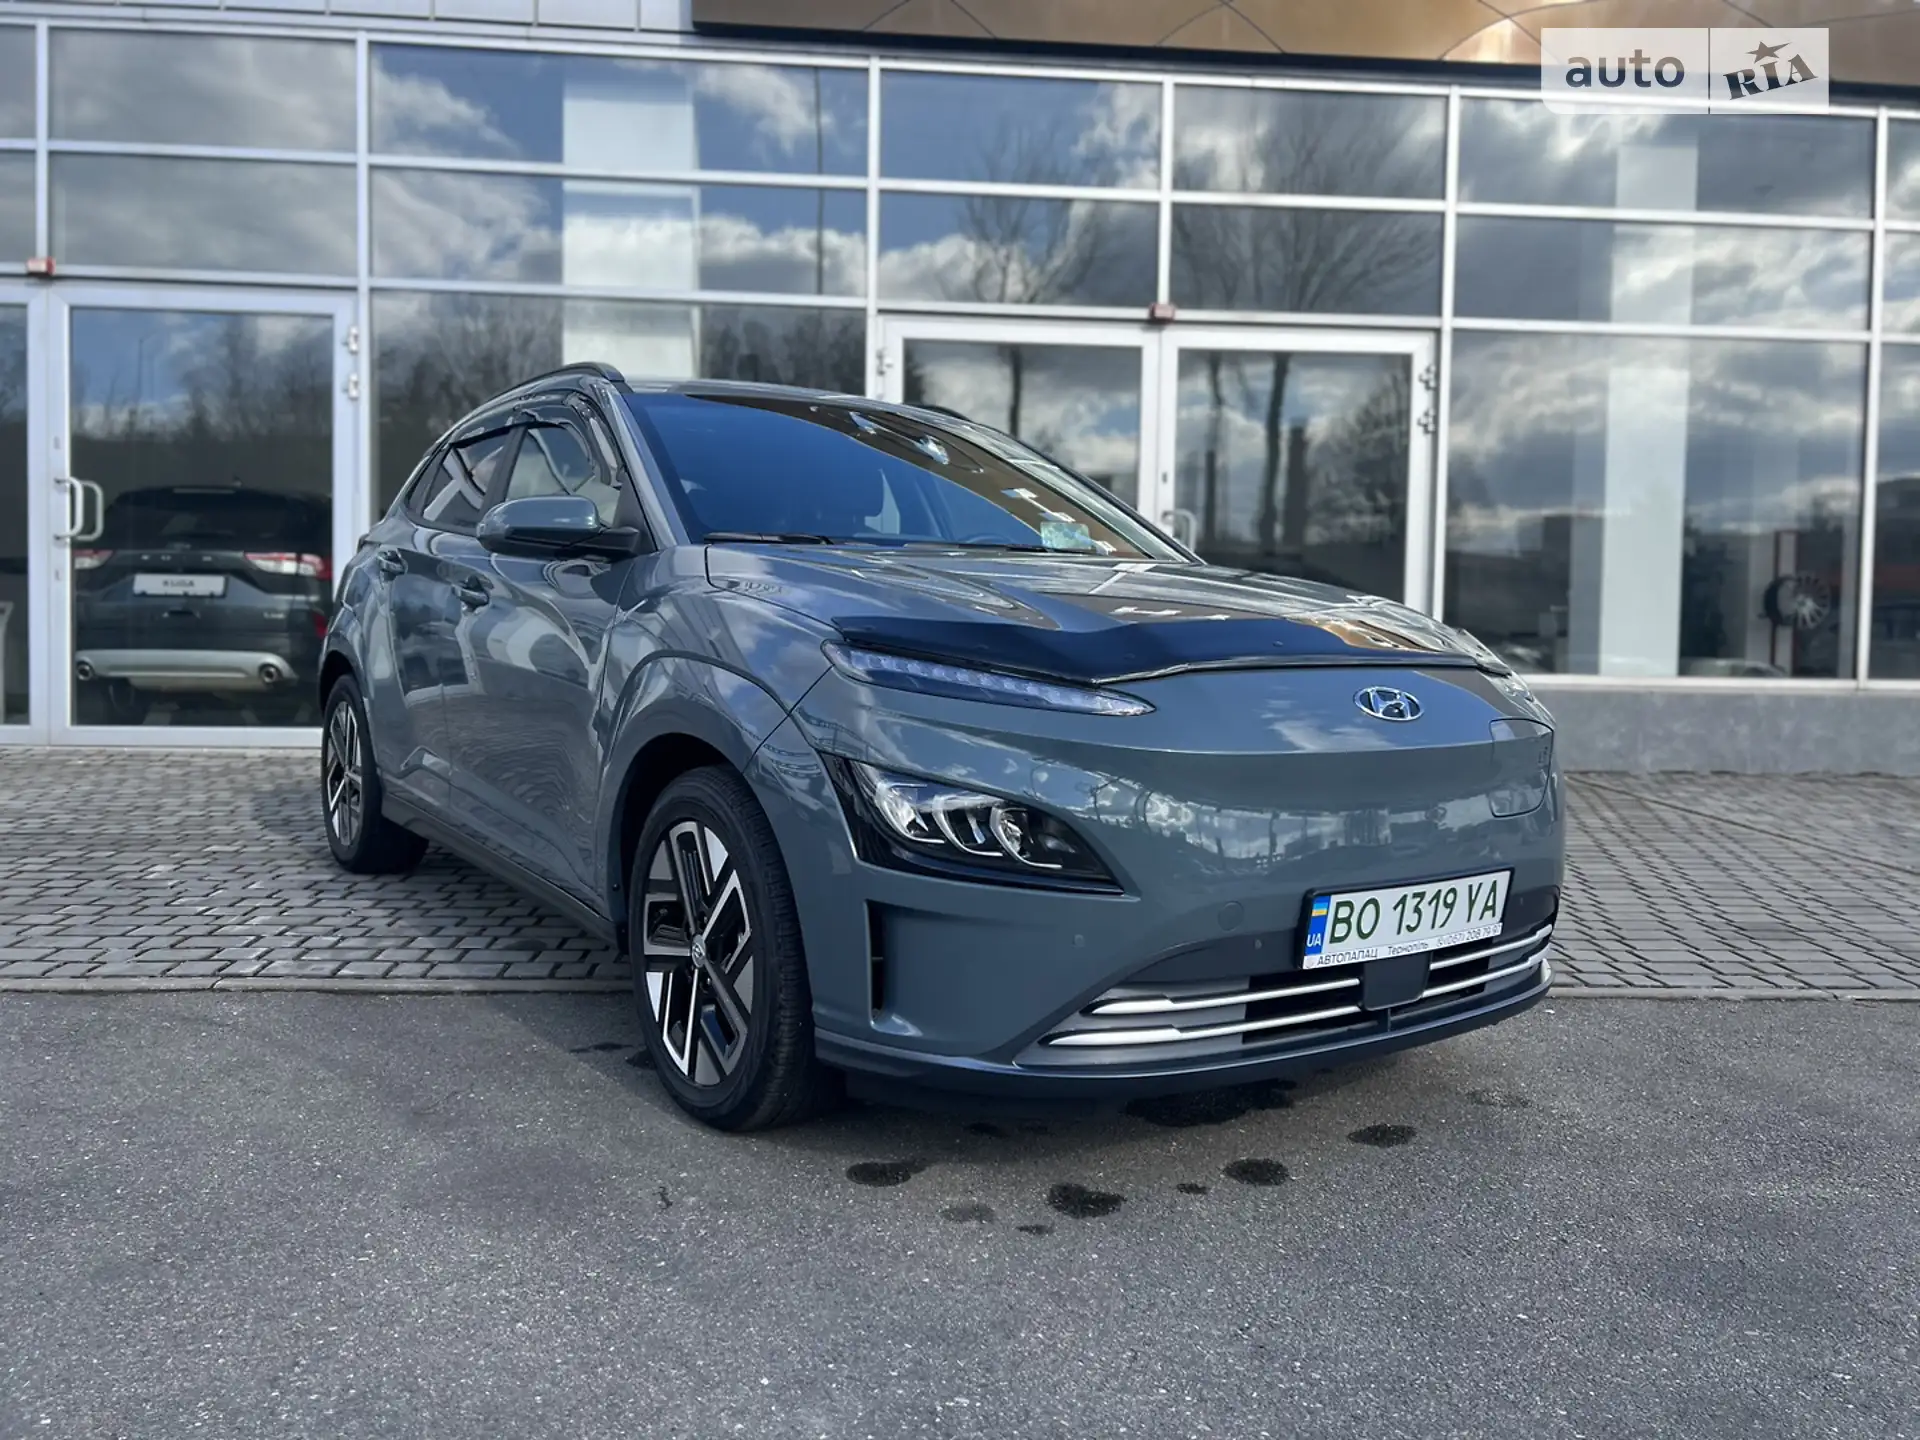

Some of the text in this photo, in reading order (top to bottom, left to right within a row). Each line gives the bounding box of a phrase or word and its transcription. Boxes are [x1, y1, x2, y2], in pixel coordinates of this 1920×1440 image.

[1329, 879, 1497, 944] BO 1319 YA
[1306, 932, 1322, 948] UA
